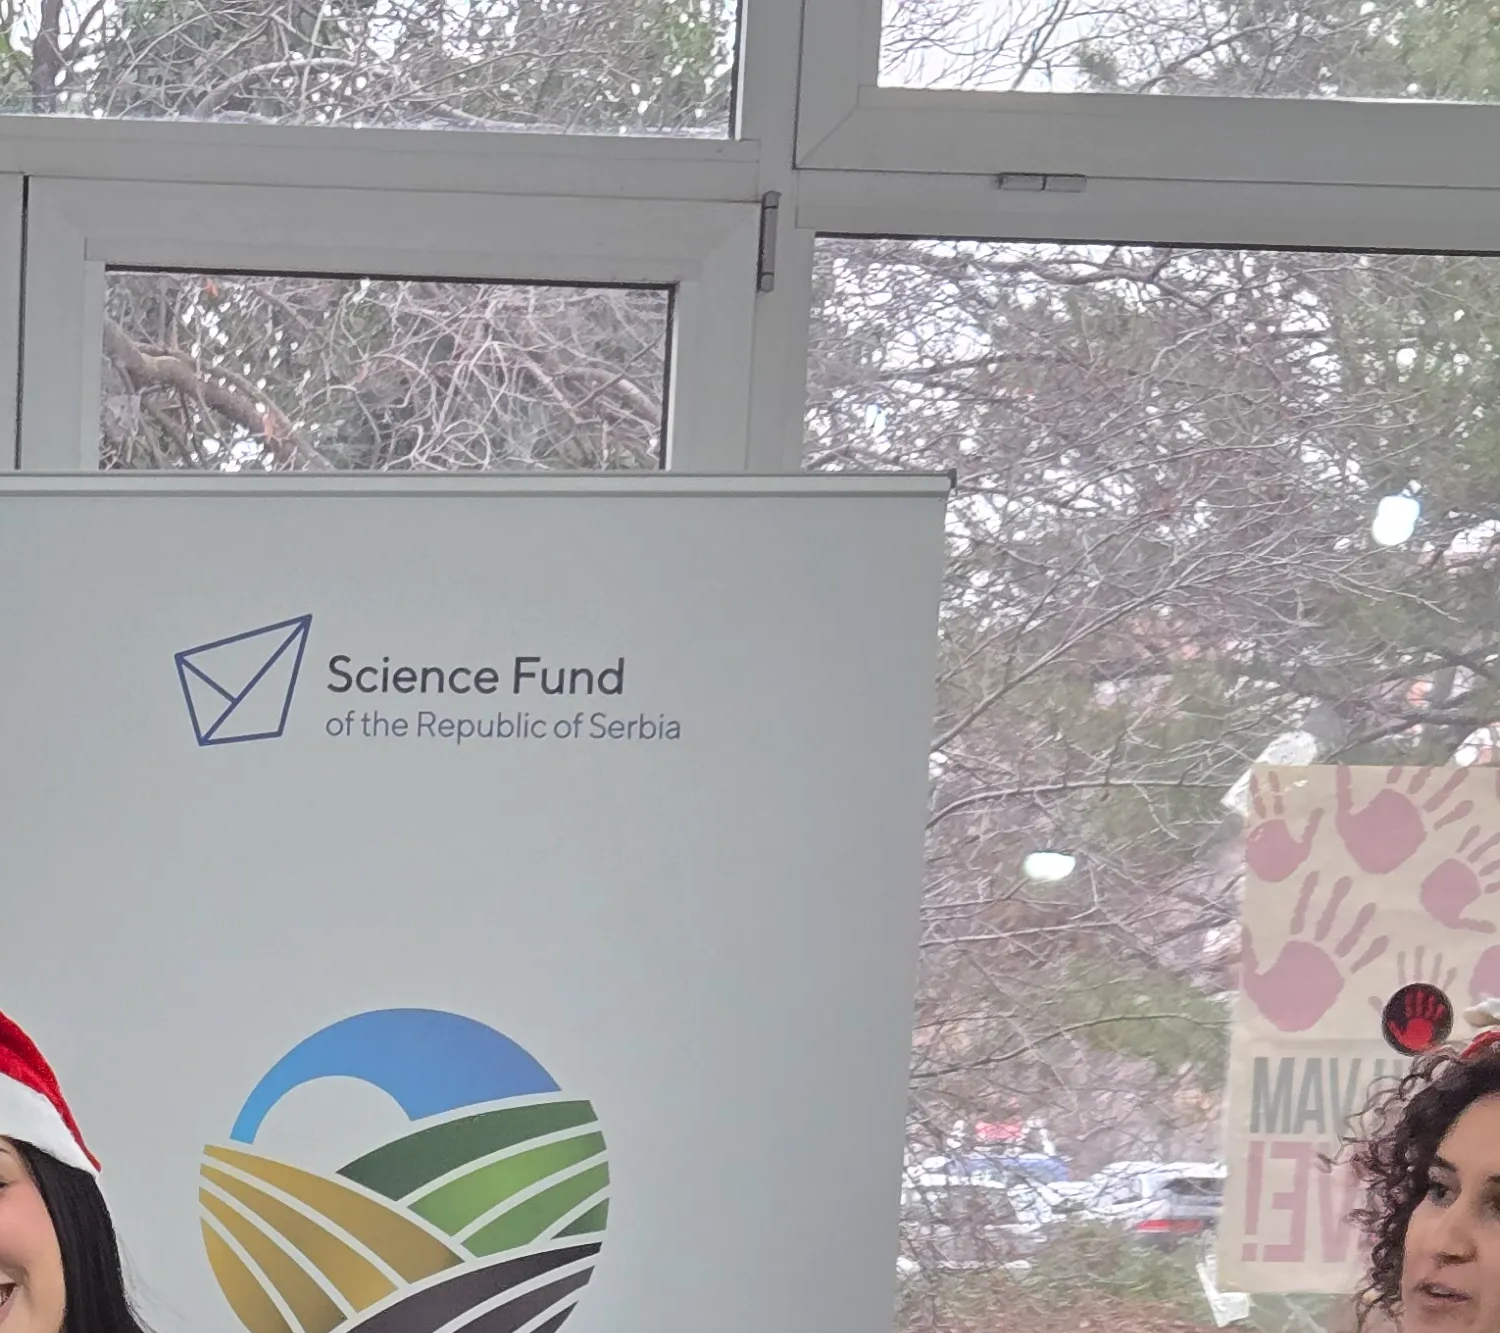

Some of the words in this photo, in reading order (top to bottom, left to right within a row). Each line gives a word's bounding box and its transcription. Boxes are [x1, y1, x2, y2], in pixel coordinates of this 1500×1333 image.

[327, 654, 499, 695] Science
[512, 656, 625, 696] Fund
[326, 711, 357, 737] of
[361, 711, 409, 738] the
[417, 712, 548, 745] Republic
[554, 712, 585, 739] of
[589, 712, 681, 741] Serbia
